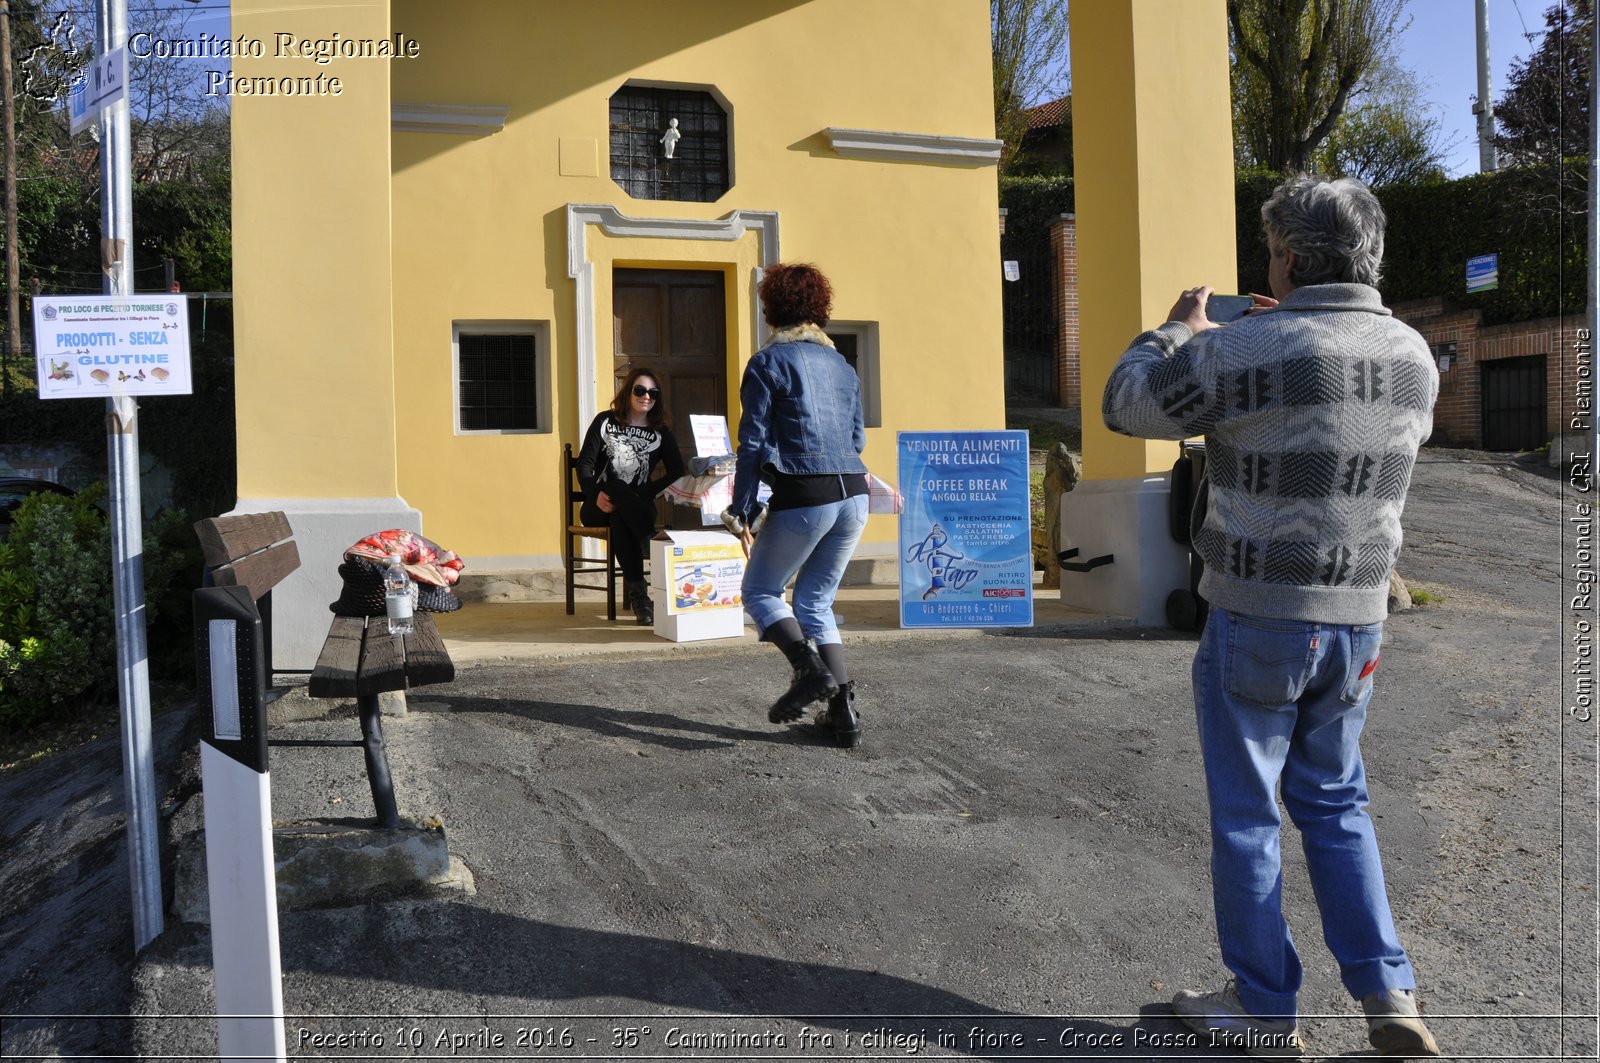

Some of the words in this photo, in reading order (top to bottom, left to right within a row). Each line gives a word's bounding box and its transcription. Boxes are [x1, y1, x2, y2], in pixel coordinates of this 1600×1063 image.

[58, 305, 72, 313] PRO
[74, 305, 92, 313] LOCO
[93, 304, 100, 312] di
[132, 304, 164, 312] TORINESE
[56, 332, 116, 347] PRODOTTI
[129, 331, 168, 345] SENZA
[78, 354, 169, 365] GLUTINE
[906, 440, 958, 452] VENDITA
[962, 439, 1020, 451] ALIMENTI
[927, 453, 949, 465] PER
[954, 453, 1000, 465] CELIACI
[920, 479, 964, 491] COFFEE
[969, 479, 1008, 491] BREAK
[932, 493, 967, 502] ANGOLO
[970, 492, 997, 501] RELAX
[922, 604, 935, 614] Via
[974, 603, 979, 613] 6
[989, 603, 1011, 613] Chieri
